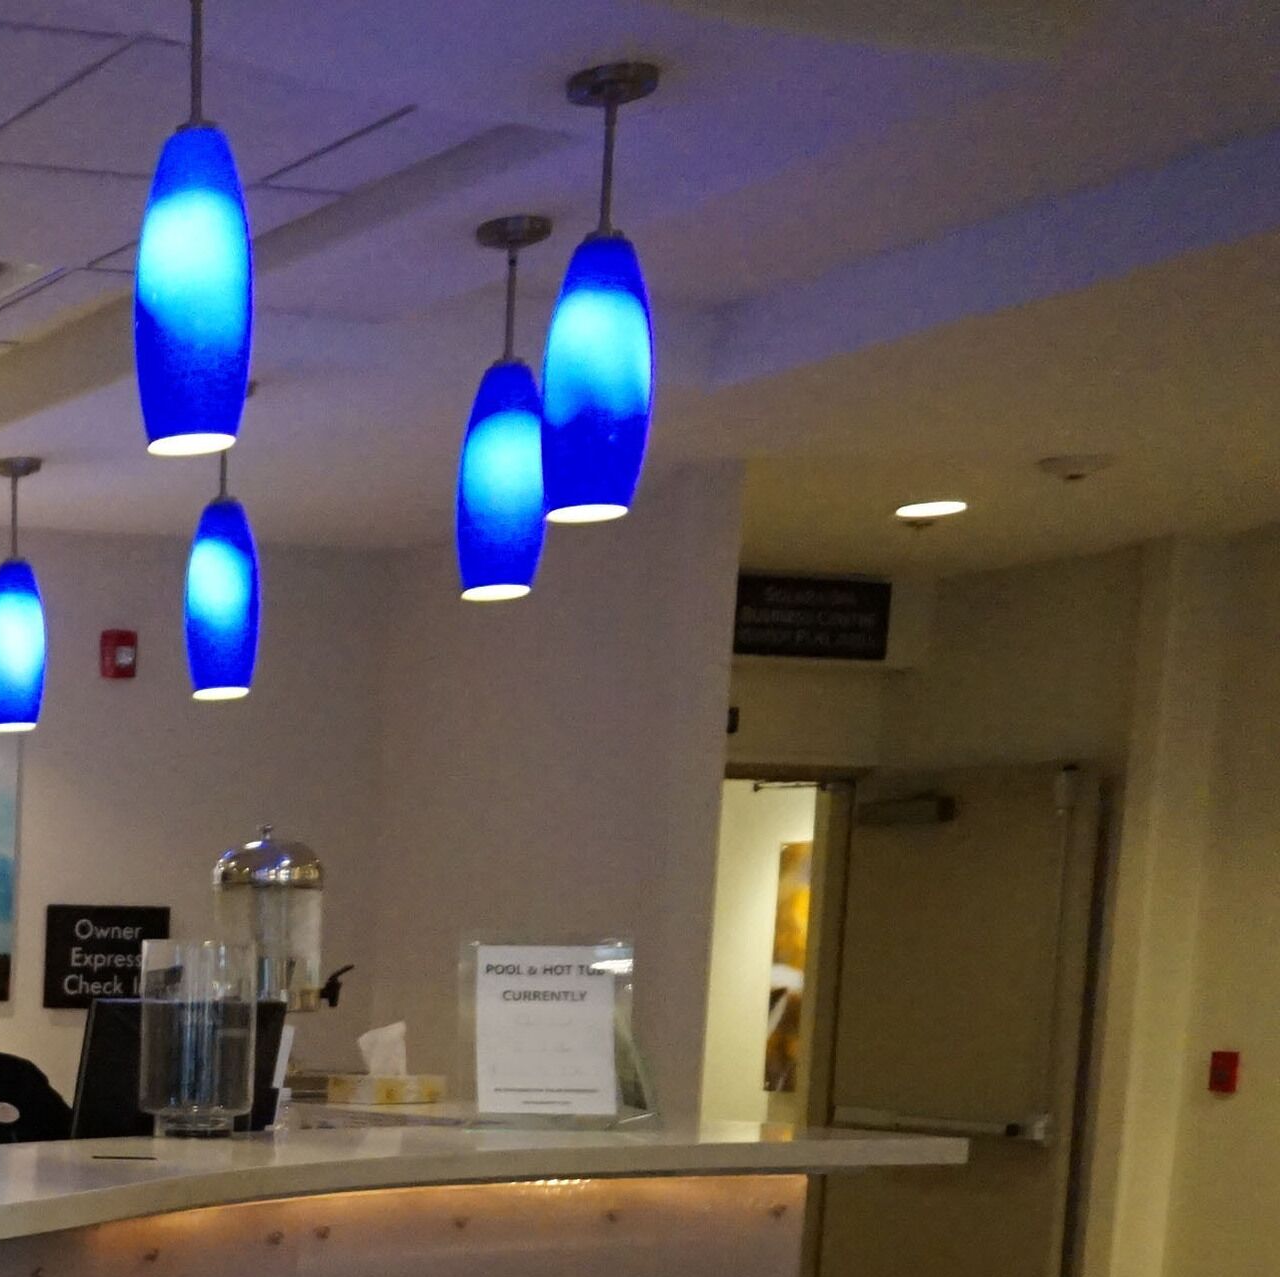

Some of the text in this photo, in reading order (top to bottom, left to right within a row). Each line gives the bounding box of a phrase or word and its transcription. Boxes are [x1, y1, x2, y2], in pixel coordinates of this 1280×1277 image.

[75, 918, 142, 940] Owner
[71, 947, 142, 972] Express
[486, 963, 521, 976] POOL
[528, 965, 537, 976] &
[543, 963, 572, 976] HOT
[64, 974, 142, 995] Check I
[502, 989, 587, 1002] CURRENTLY
